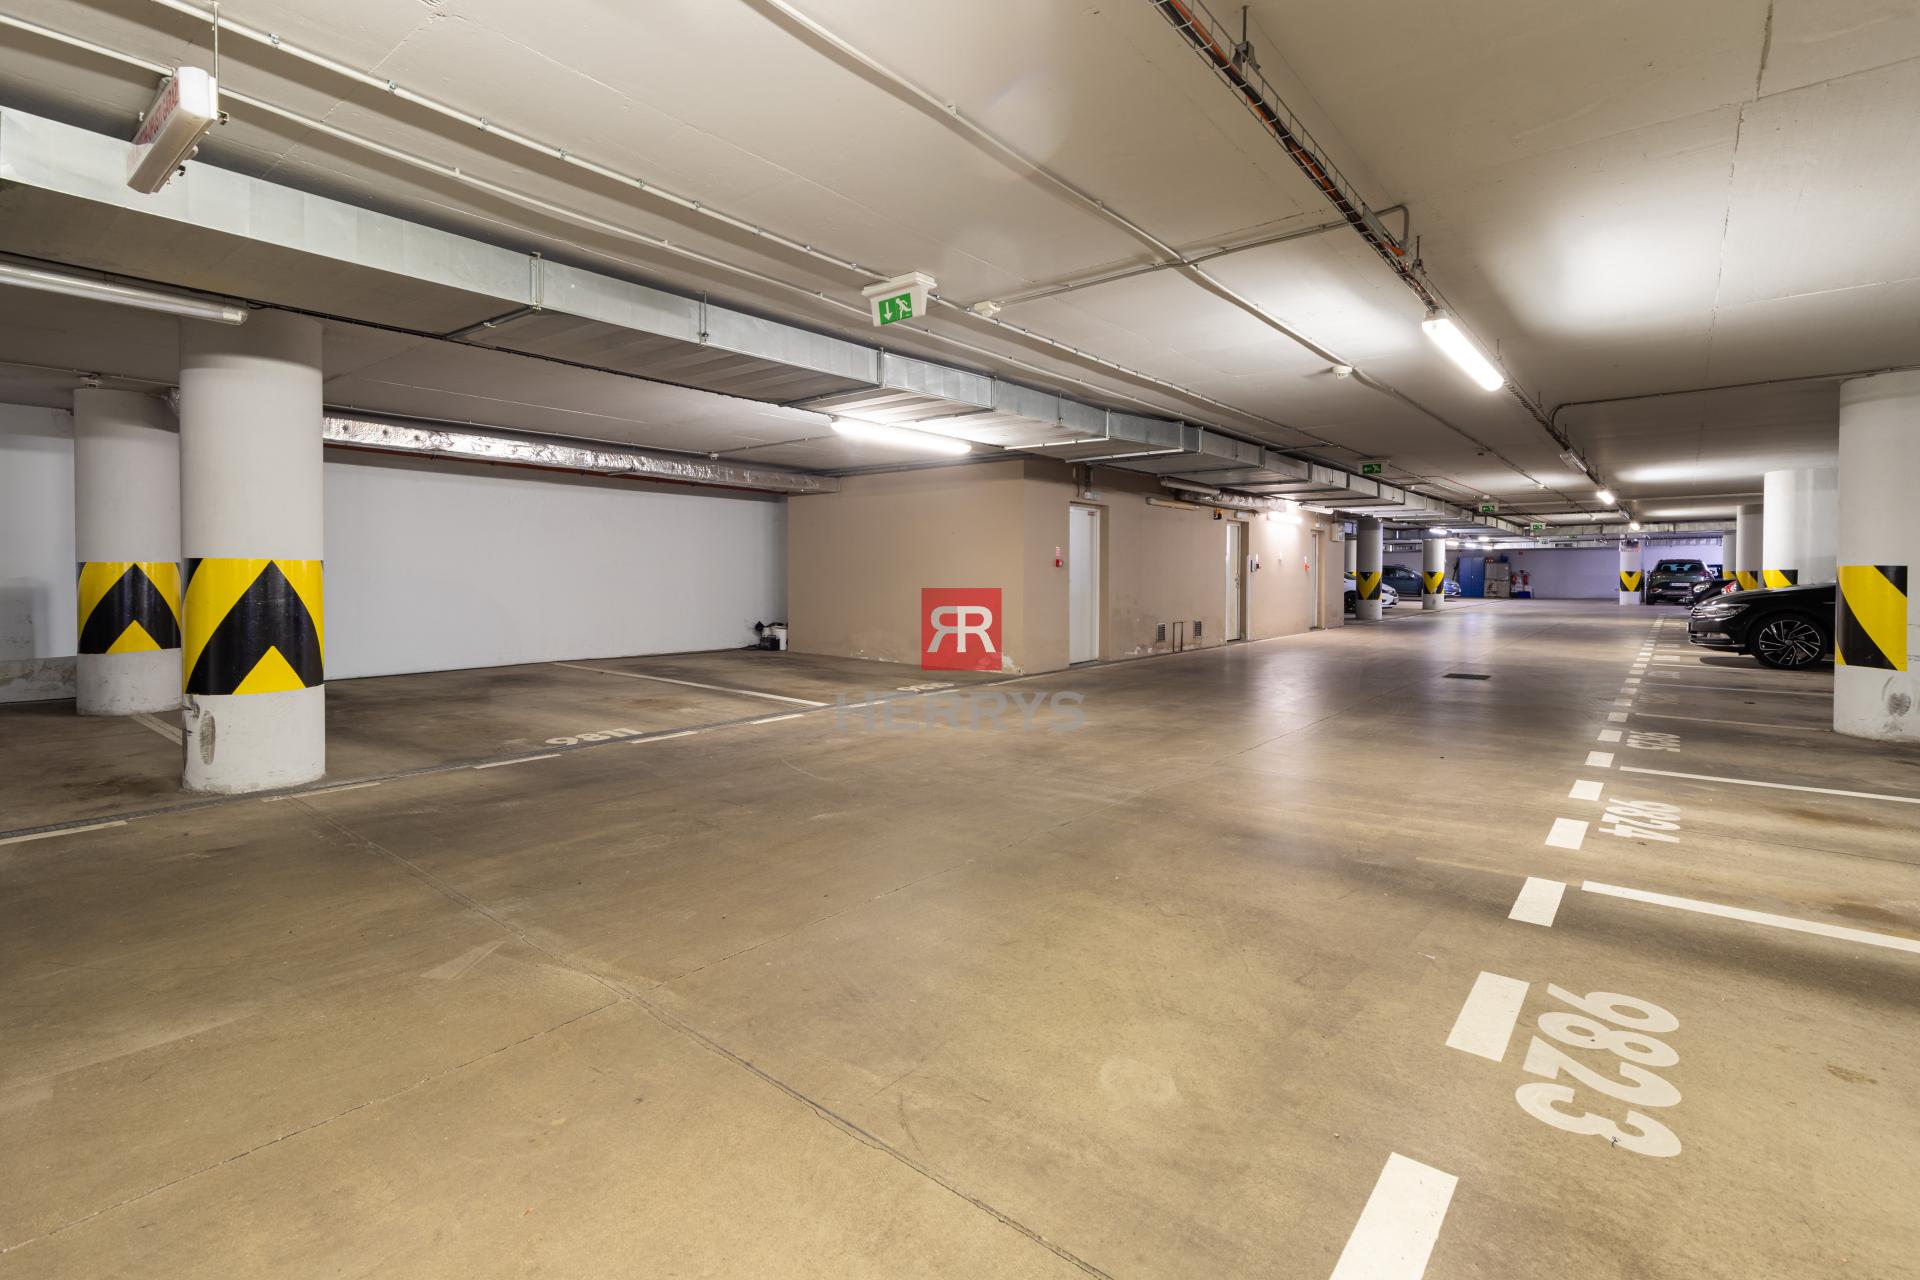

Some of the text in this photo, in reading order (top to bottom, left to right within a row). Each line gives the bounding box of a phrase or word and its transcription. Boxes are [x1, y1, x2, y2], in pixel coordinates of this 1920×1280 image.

[545, 728, 643, 746] 9811
[1598, 798, 1681, 843] 9824
[1515, 983, 1682, 1158] 9823
